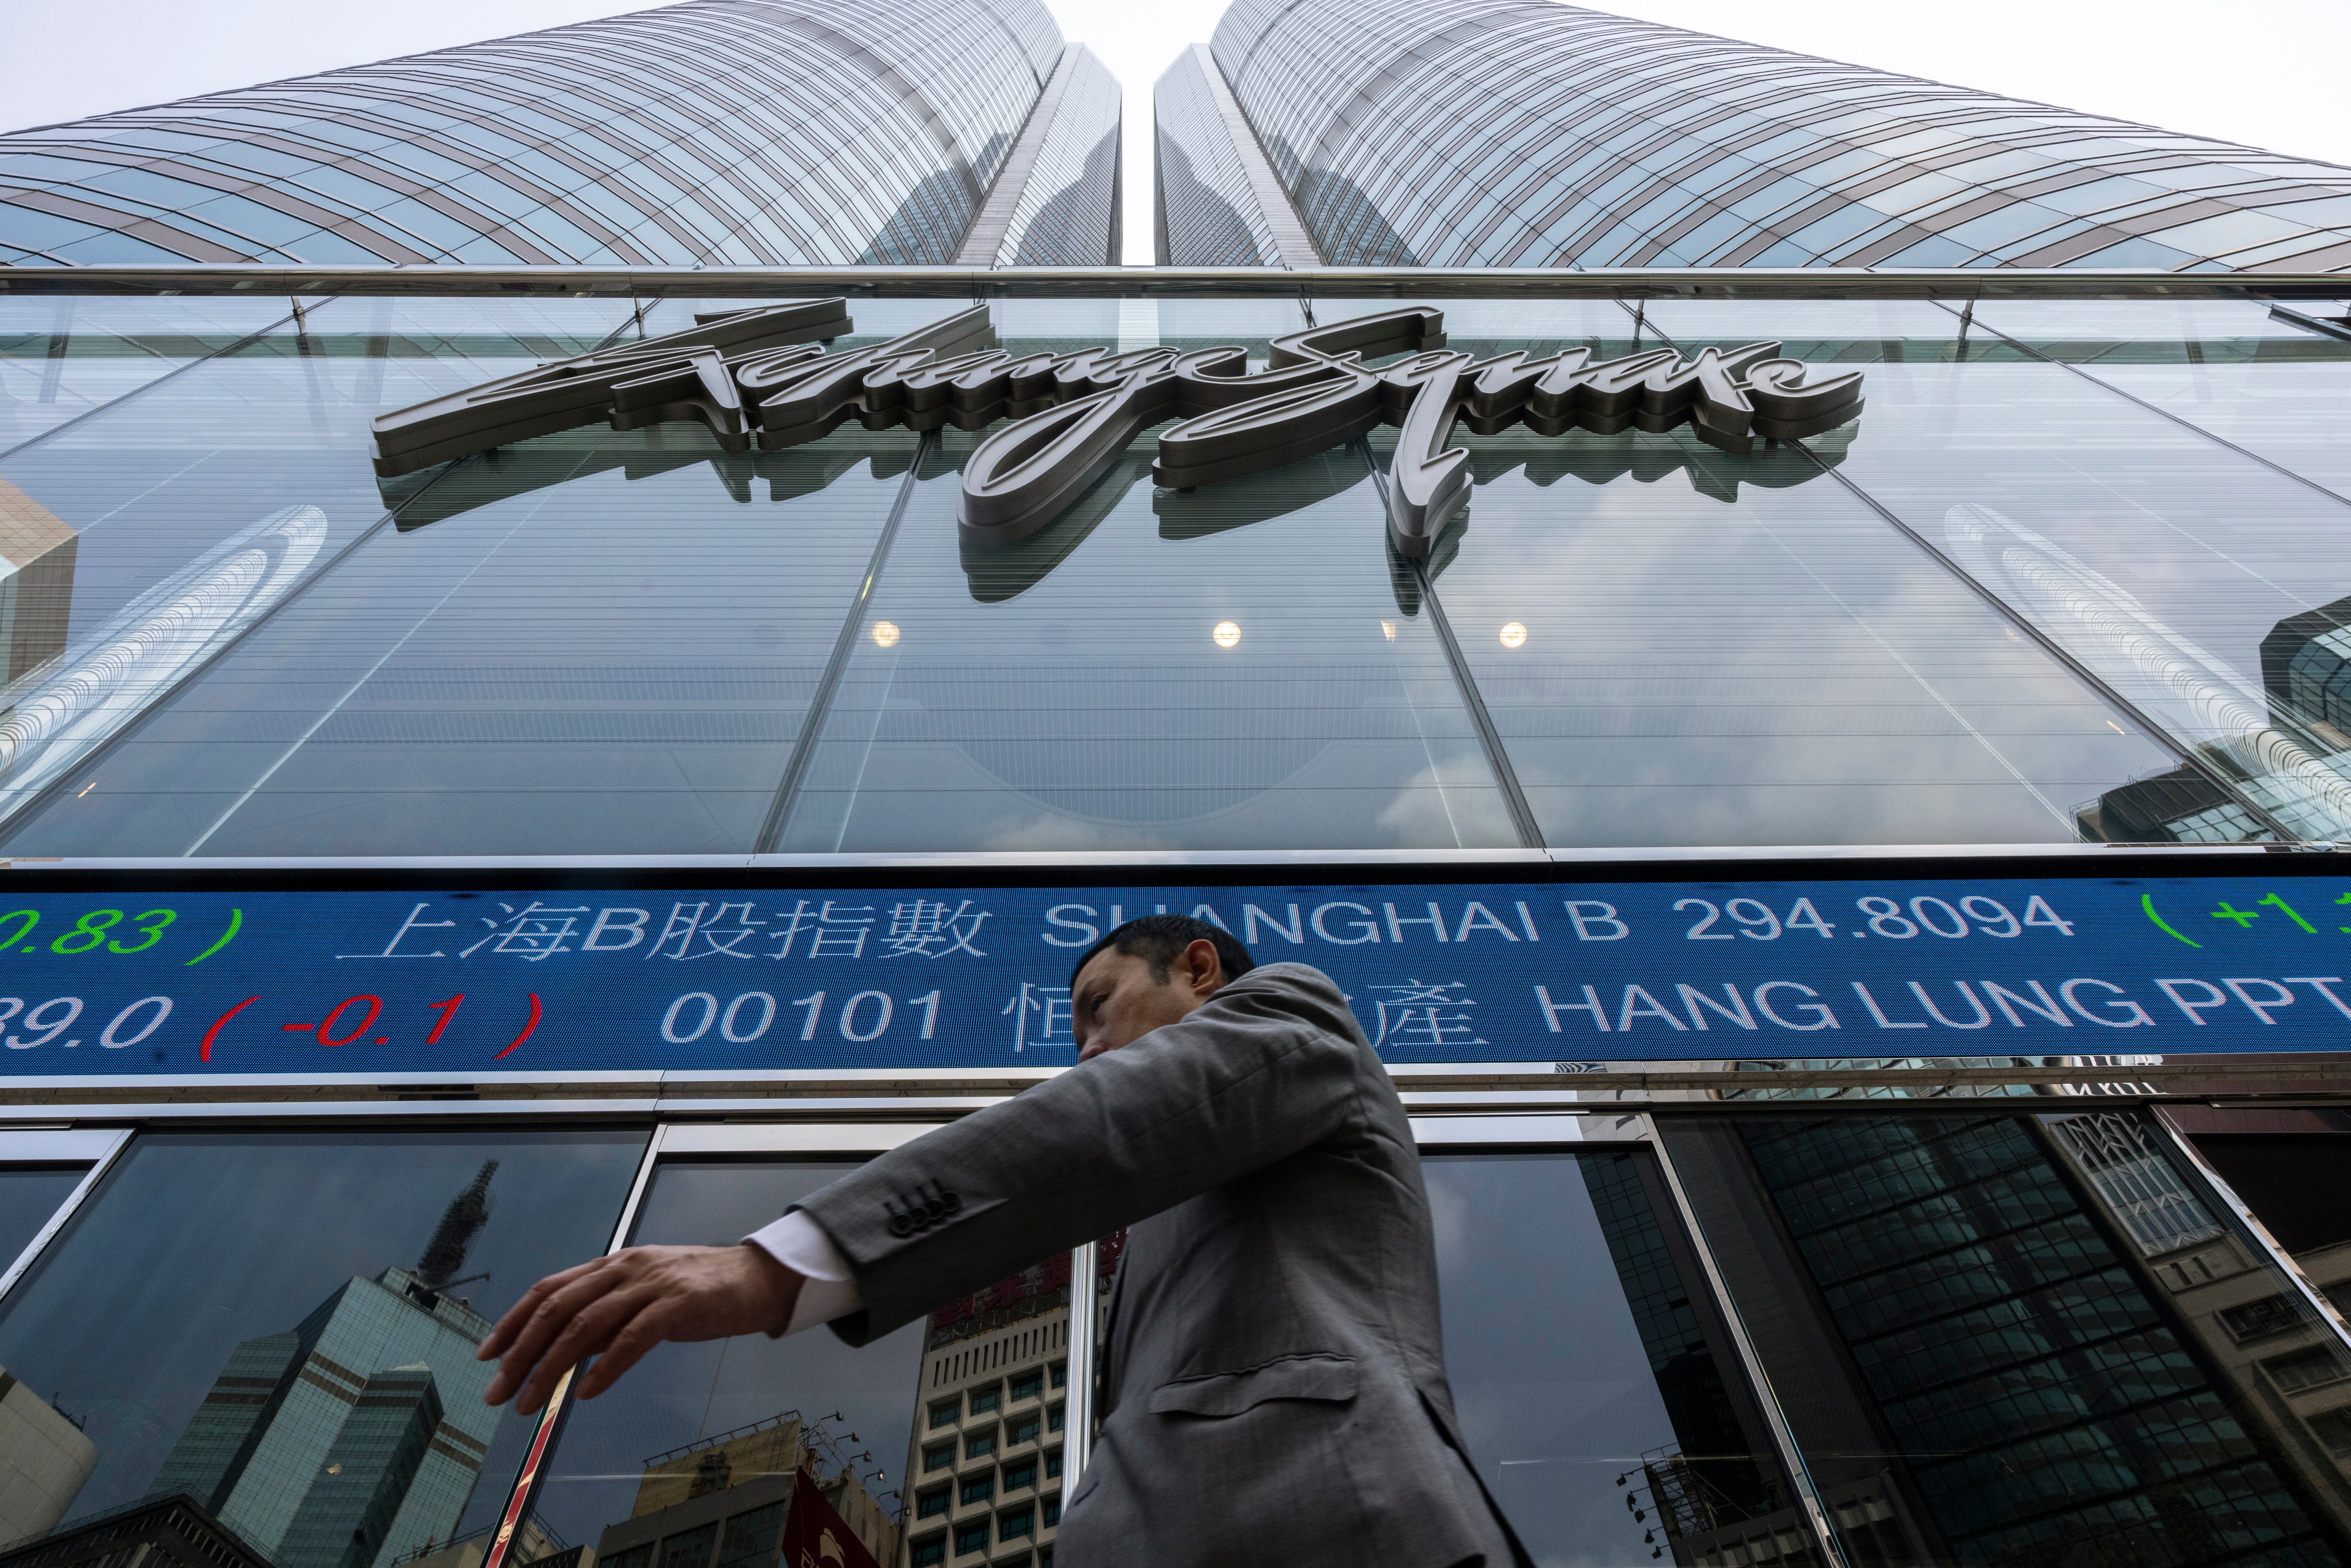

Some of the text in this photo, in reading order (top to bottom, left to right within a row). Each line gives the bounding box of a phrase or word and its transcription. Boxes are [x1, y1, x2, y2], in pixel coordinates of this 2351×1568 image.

[1152, 306, 1866, 558] Square
[1564, 900, 1629, 941] B
[1673, 896, 2074, 940] 294.8094
[661, 991, 940, 1043] 00101
[1535, 981, 1840, 1033] HANG
[1852, 979, 2156, 1028] LUNG
[2154, 977, 2351, 1026] PPT
